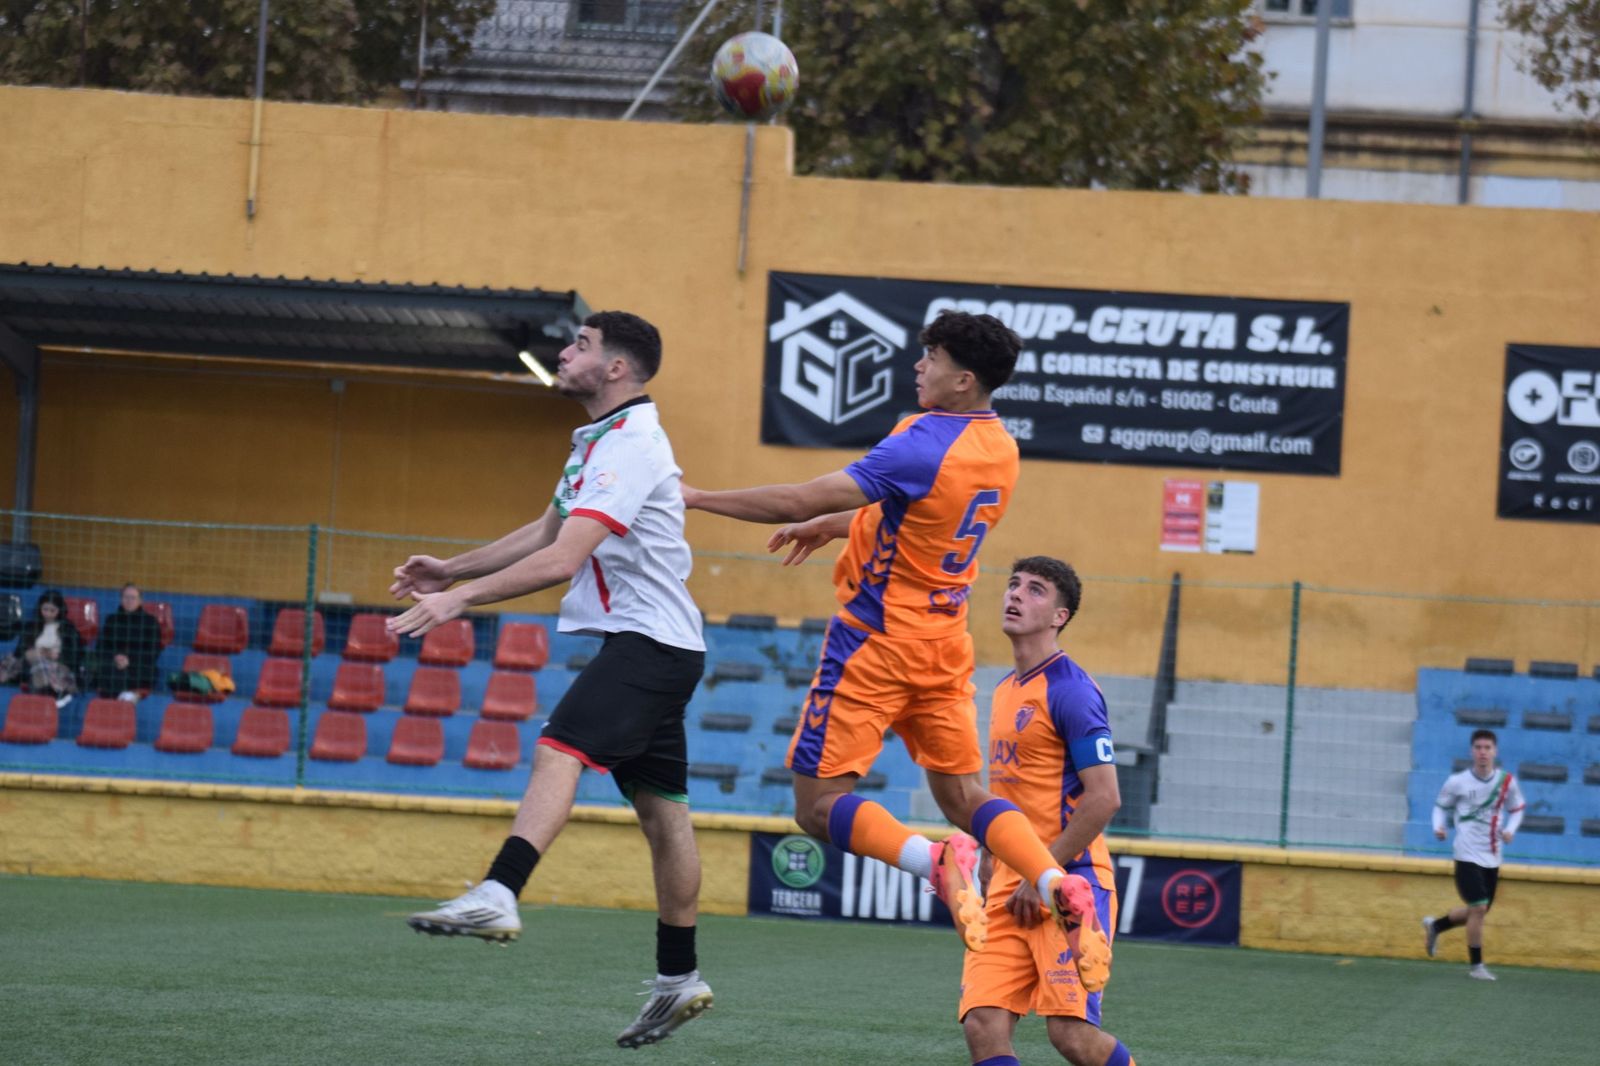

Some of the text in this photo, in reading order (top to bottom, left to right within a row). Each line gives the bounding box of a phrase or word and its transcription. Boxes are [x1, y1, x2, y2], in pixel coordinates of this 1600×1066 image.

[1246, 314, 1335, 356] S.L.
[1042, 352, 1162, 381] CORRECTA
[1166, 359, 1199, 382] DE
[1203, 361, 1337, 389] CONSTRUIR
[1044, 383, 1112, 407] Español
[1115, 387, 1145, 408] s/n
[1161, 390, 1214, 411] 51002
[1228, 394, 1280, 415] Ceuta
[1110, 427, 1313, 455] aggroup@gmail.com
[940, 489, 1000, 575] 5
[1095, 737, 1113, 762] C
[772, 888, 822, 909] TERCERA
